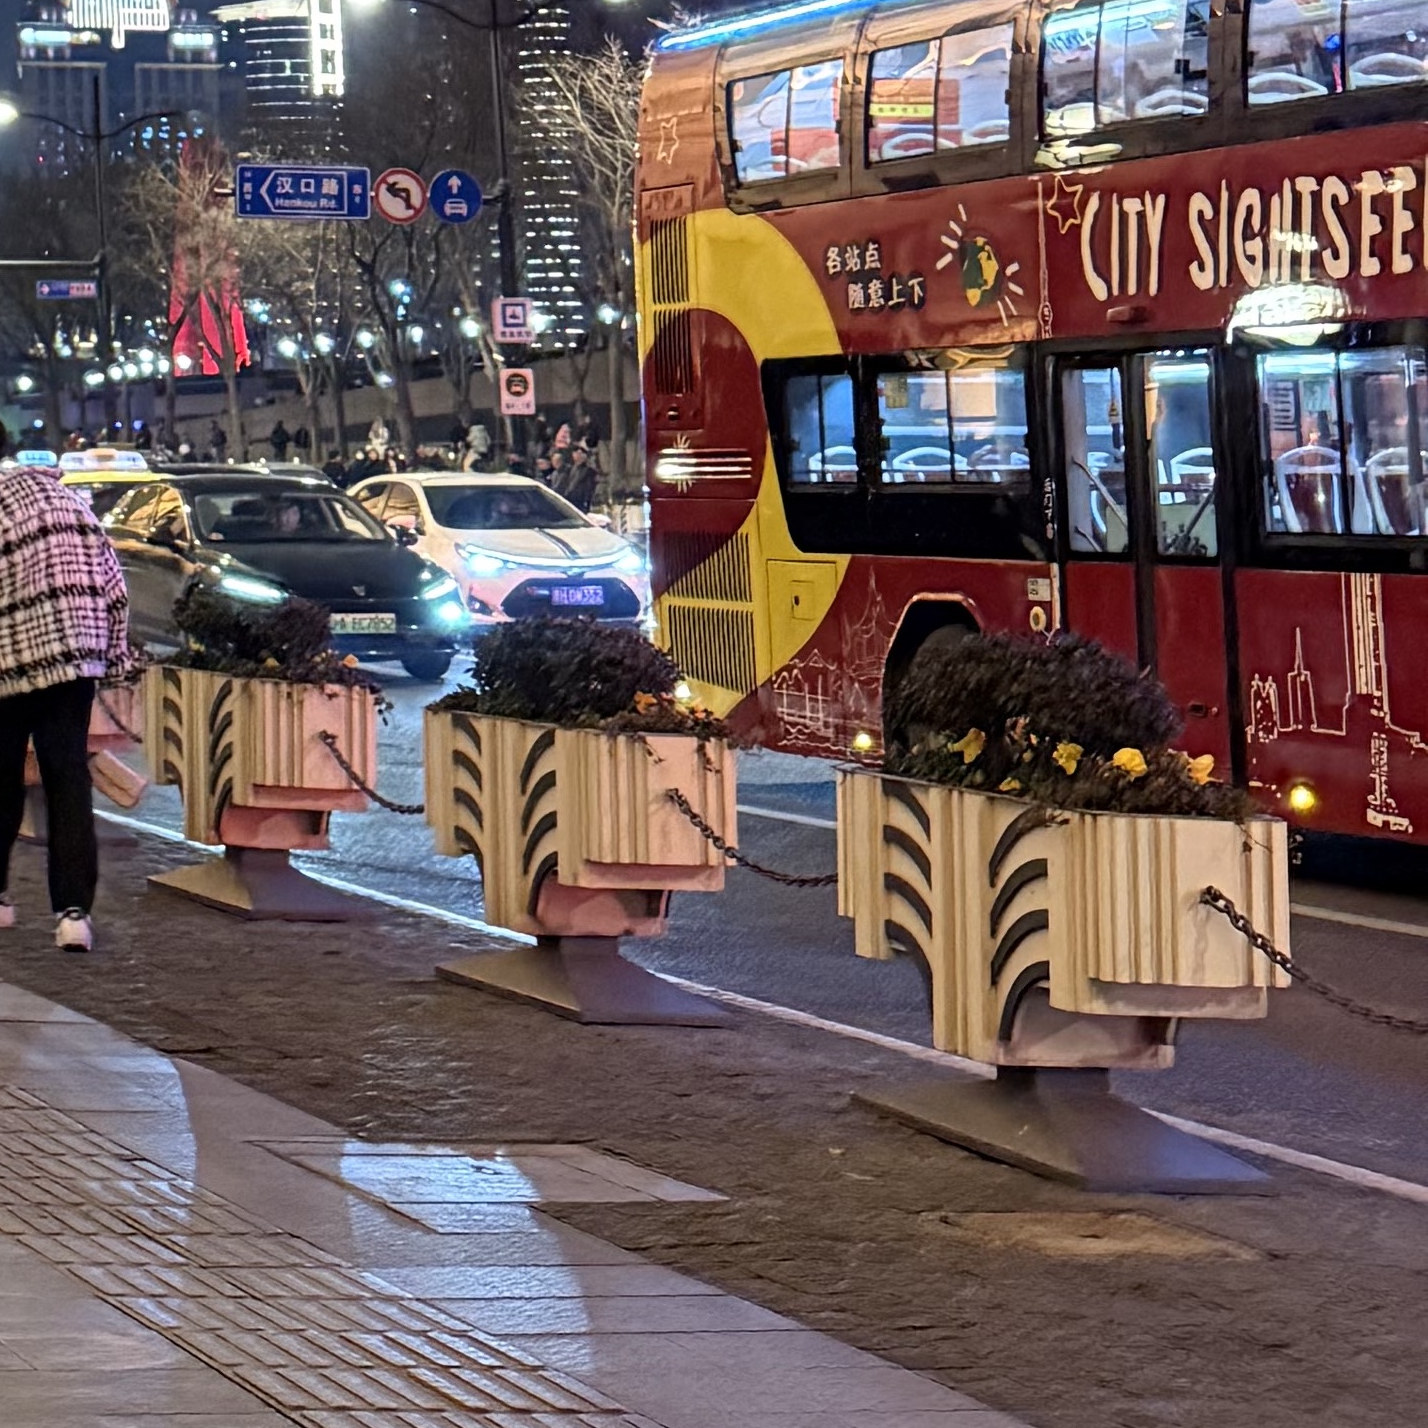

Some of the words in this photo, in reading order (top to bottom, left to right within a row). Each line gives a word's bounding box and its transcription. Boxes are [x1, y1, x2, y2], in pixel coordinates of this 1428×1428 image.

[276, 176, 339, 195] 汉口路
[274, 197, 318, 209] Hankou
[826, 241, 882, 276] 各站点
[1080, 190, 1166, 301] CITY
[847, 277, 925, 310] 随意上下
